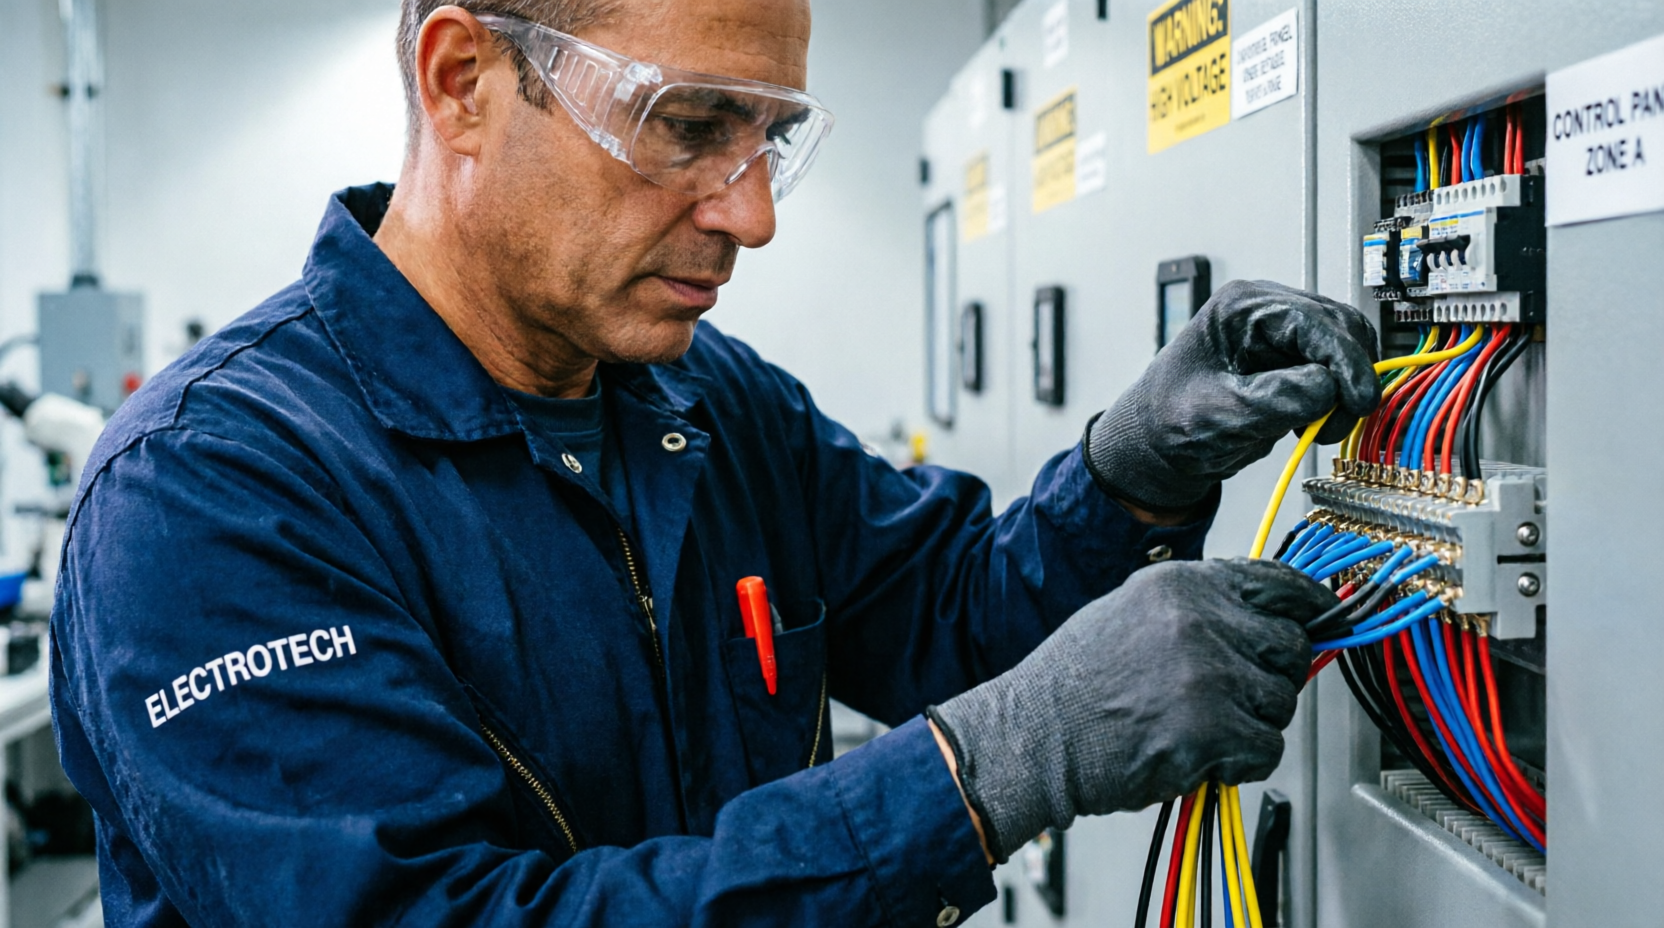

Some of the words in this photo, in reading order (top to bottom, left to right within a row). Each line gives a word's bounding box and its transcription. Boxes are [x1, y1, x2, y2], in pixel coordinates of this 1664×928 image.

[1151, 86, 1173, 121] HIGH
[1174, 52, 1226, 112] VOLTAGE
[1553, 98, 1625, 141] CONTROL
[1586, 139, 1627, 176] ZONE
[1632, 136, 1646, 166] A
[144, 625, 357, 729] ELECTROTECH
